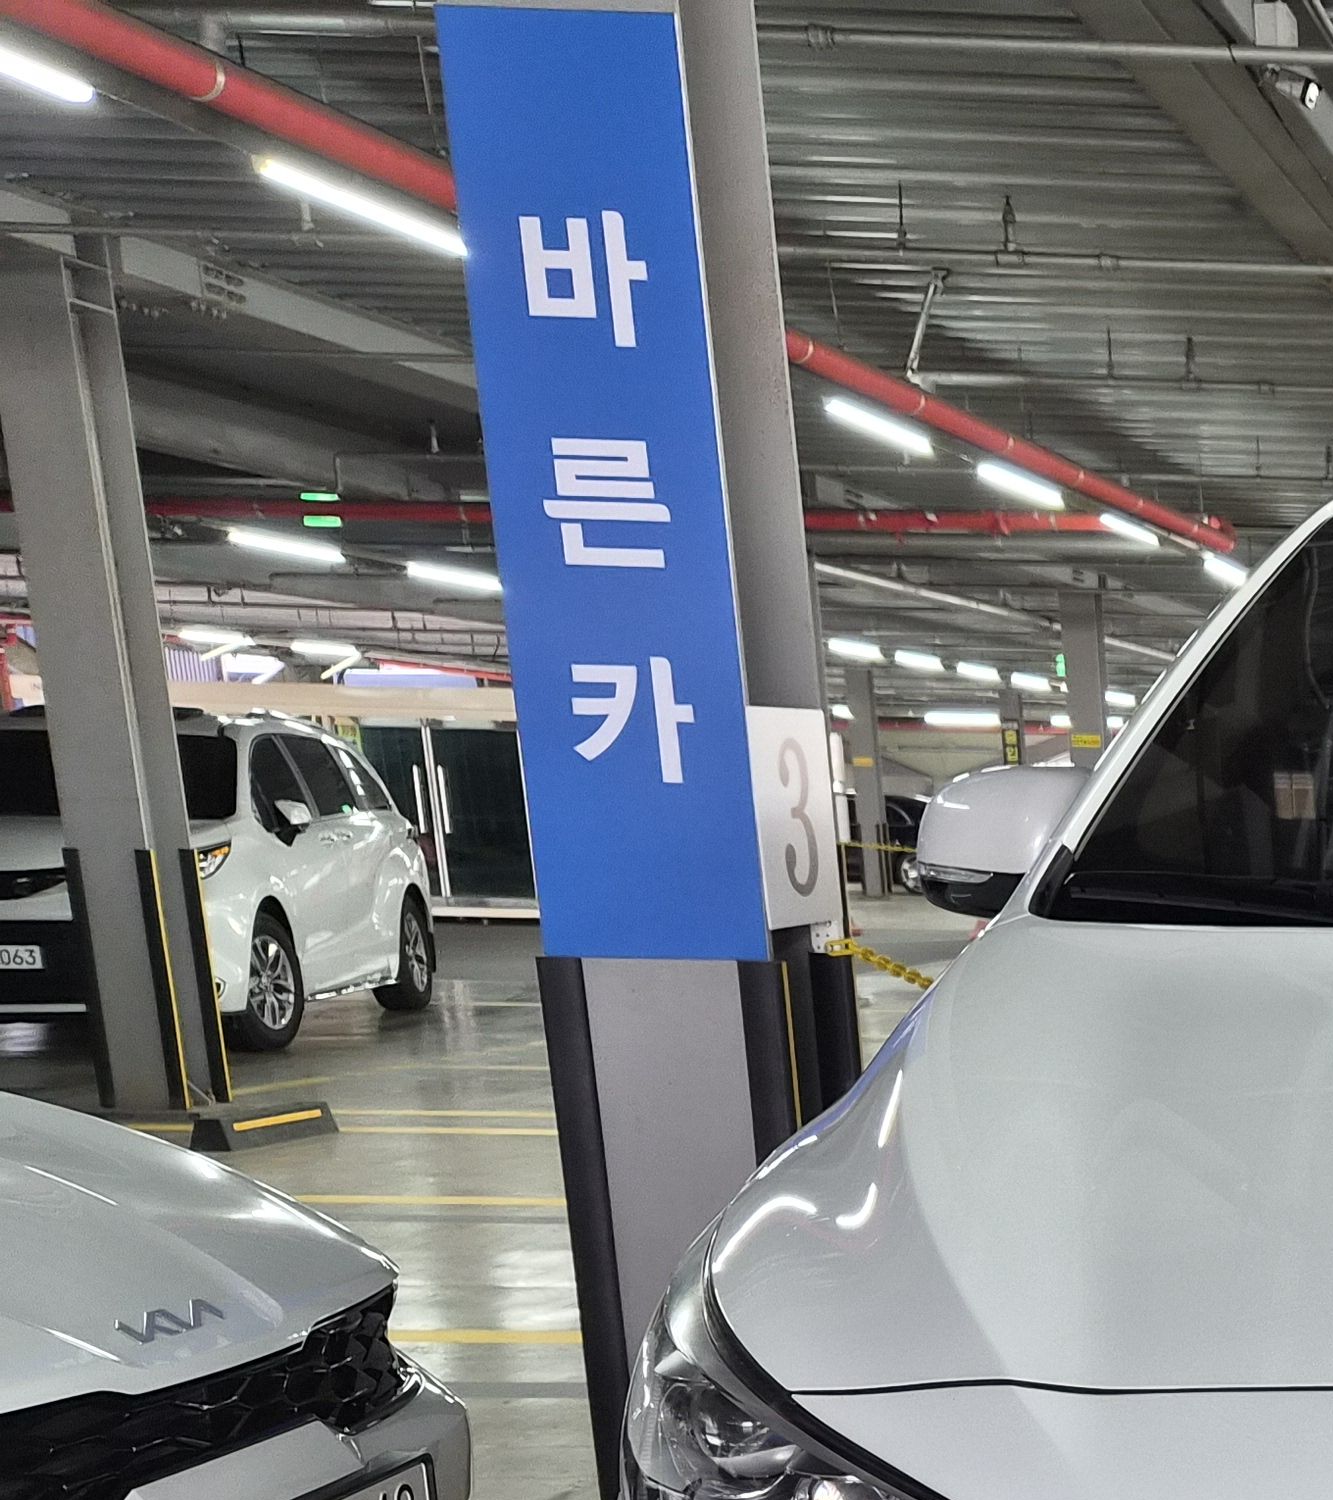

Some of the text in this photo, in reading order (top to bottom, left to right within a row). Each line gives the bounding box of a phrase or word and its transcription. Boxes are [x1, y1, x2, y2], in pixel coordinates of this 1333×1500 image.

[518, 210, 695, 784] 바른카
[778, 737, 819, 897] 3
[114, 1298, 225, 1344] KIA
